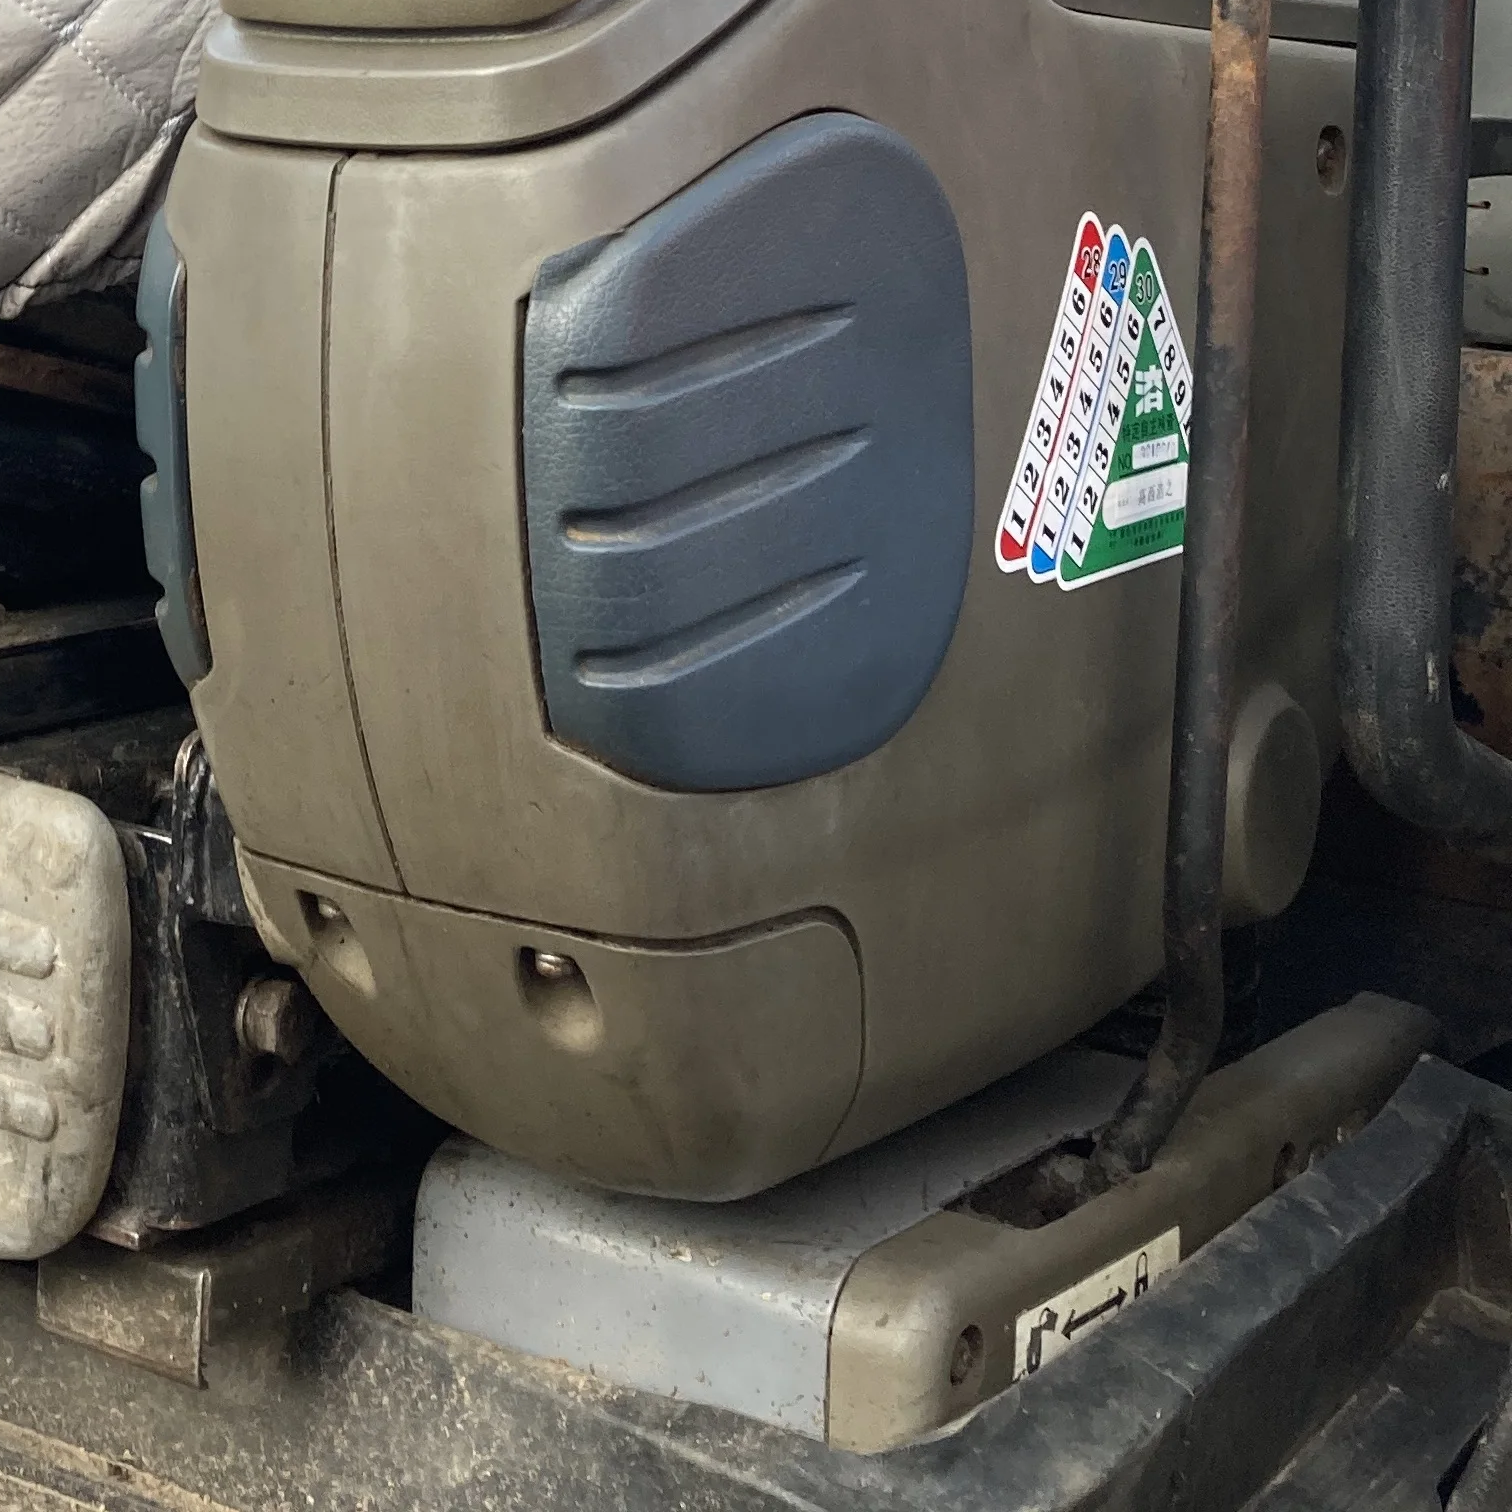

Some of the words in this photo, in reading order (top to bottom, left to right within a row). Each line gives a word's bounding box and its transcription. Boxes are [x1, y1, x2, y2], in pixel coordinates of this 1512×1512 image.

[1081, 245, 1100, 279] 28
[1110, 259, 1127, 292] 29
[1073, 287, 1085, 315] 6
[1136, 271, 1154, 305] 30
[1100, 301, 1112, 328] 6
[1128, 314, 1138, 340] 6
[1154, 306, 1165, 331] 7
[1061, 329, 1074, 360] 5
[1089, 343, 1102, 373] 5
[1164, 344, 1175, 371] 8
[1117, 354, 1129, 384] 5
[1050, 375, 1064, 402] 4
[1080, 389, 1093, 415] 4
[1136, 365, 1163, 417] 済
[1175, 380, 1185, 405] 9
[1108, 400, 1121, 427] 4
[1037, 418, 1051, 447] 3
[1067, 432, 1080, 460] 3
[1096, 442, 1109, 470] 3
[1025, 462, 1038, 493] 2
[1055, 476, 1069, 506] 2
[1084, 485, 1098, 514] 2
[1012, 509, 1025, 535] 1
[1042, 523, 1056, 549] 1
[1071, 532, 1085, 556] 1
